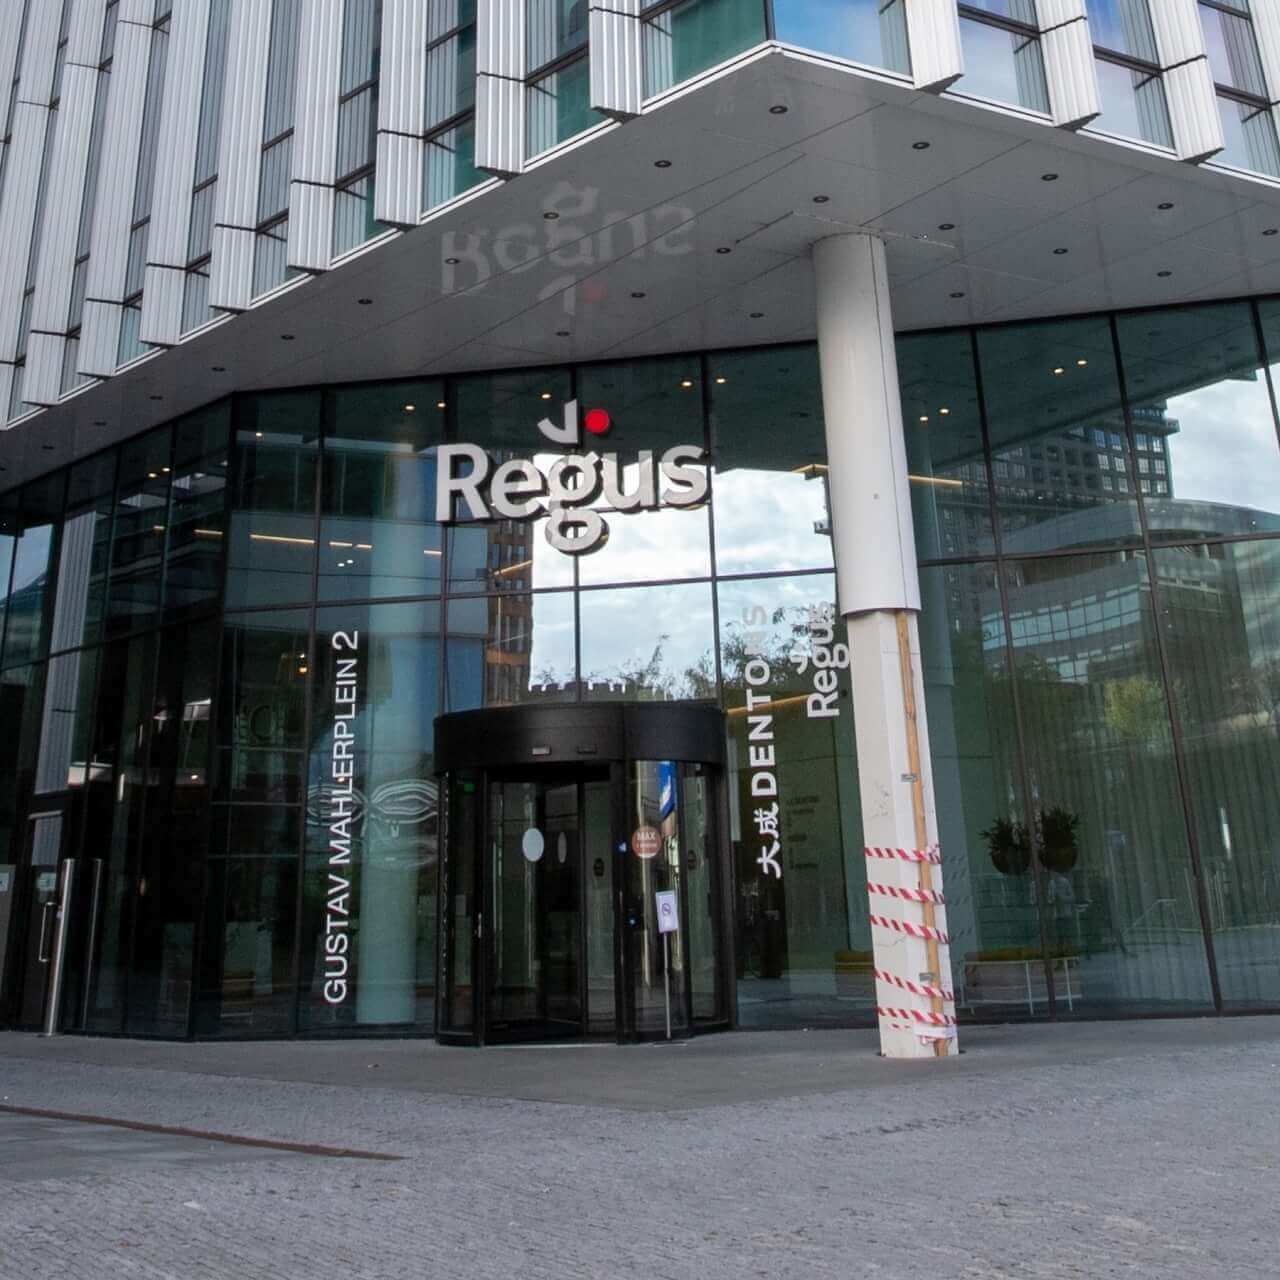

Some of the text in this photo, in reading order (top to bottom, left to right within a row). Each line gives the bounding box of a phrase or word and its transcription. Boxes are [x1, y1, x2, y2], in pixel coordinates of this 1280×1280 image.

[435, 437, 710, 552] Regus
[744, 605, 781, 879] 大成 DENTONS
[807, 600, 851, 718] Regus
[324, 630, 359, 1003] GUSTAV MAHLERPLEIN 2
